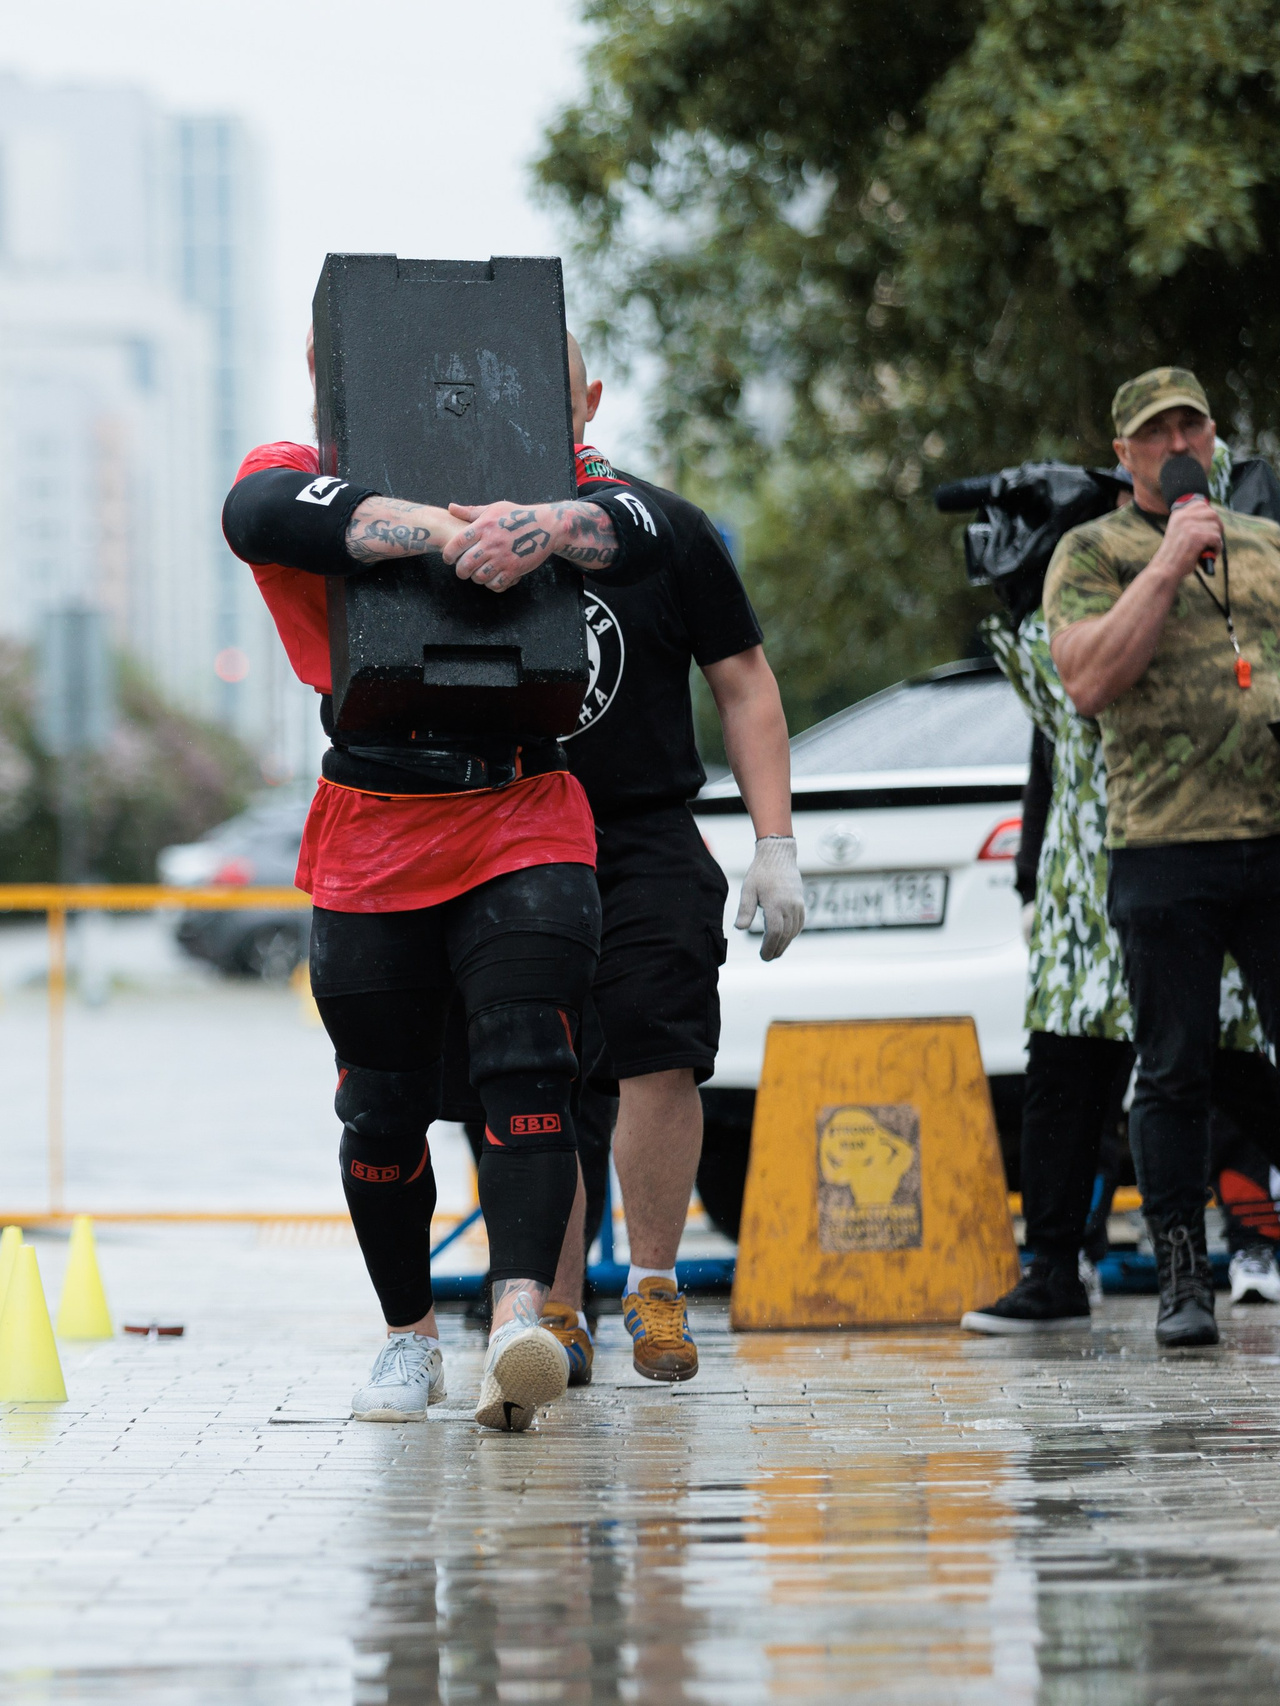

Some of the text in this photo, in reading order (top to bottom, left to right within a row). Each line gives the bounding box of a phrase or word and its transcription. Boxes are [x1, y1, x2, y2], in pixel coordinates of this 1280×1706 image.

[367, 519, 431, 542] GOD
[513, 1117, 558, 1132] SBD
[354, 1164, 396, 1180] SBD
